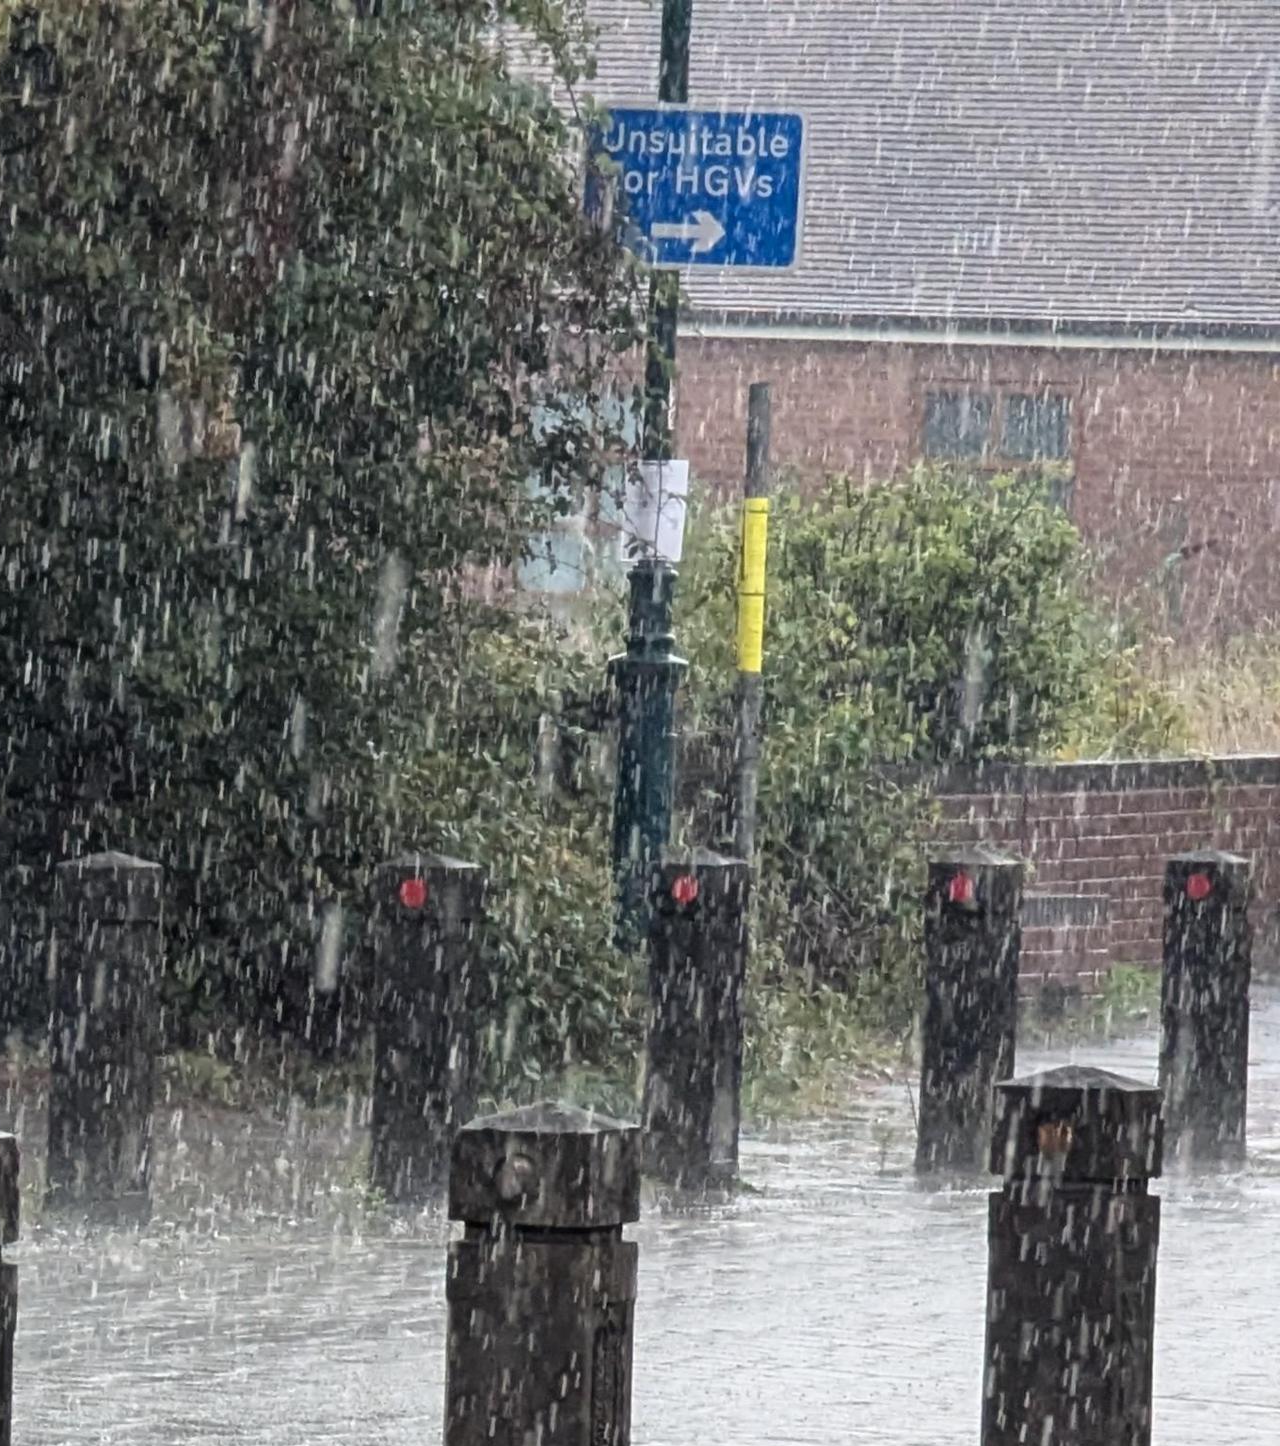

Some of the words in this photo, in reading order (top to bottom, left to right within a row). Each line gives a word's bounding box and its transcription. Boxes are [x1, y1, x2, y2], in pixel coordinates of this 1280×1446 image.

[602, 122, 789, 158] Unsuitable
[620, 166, 659, 195] or
[676, 165, 774, 198] HGVs
